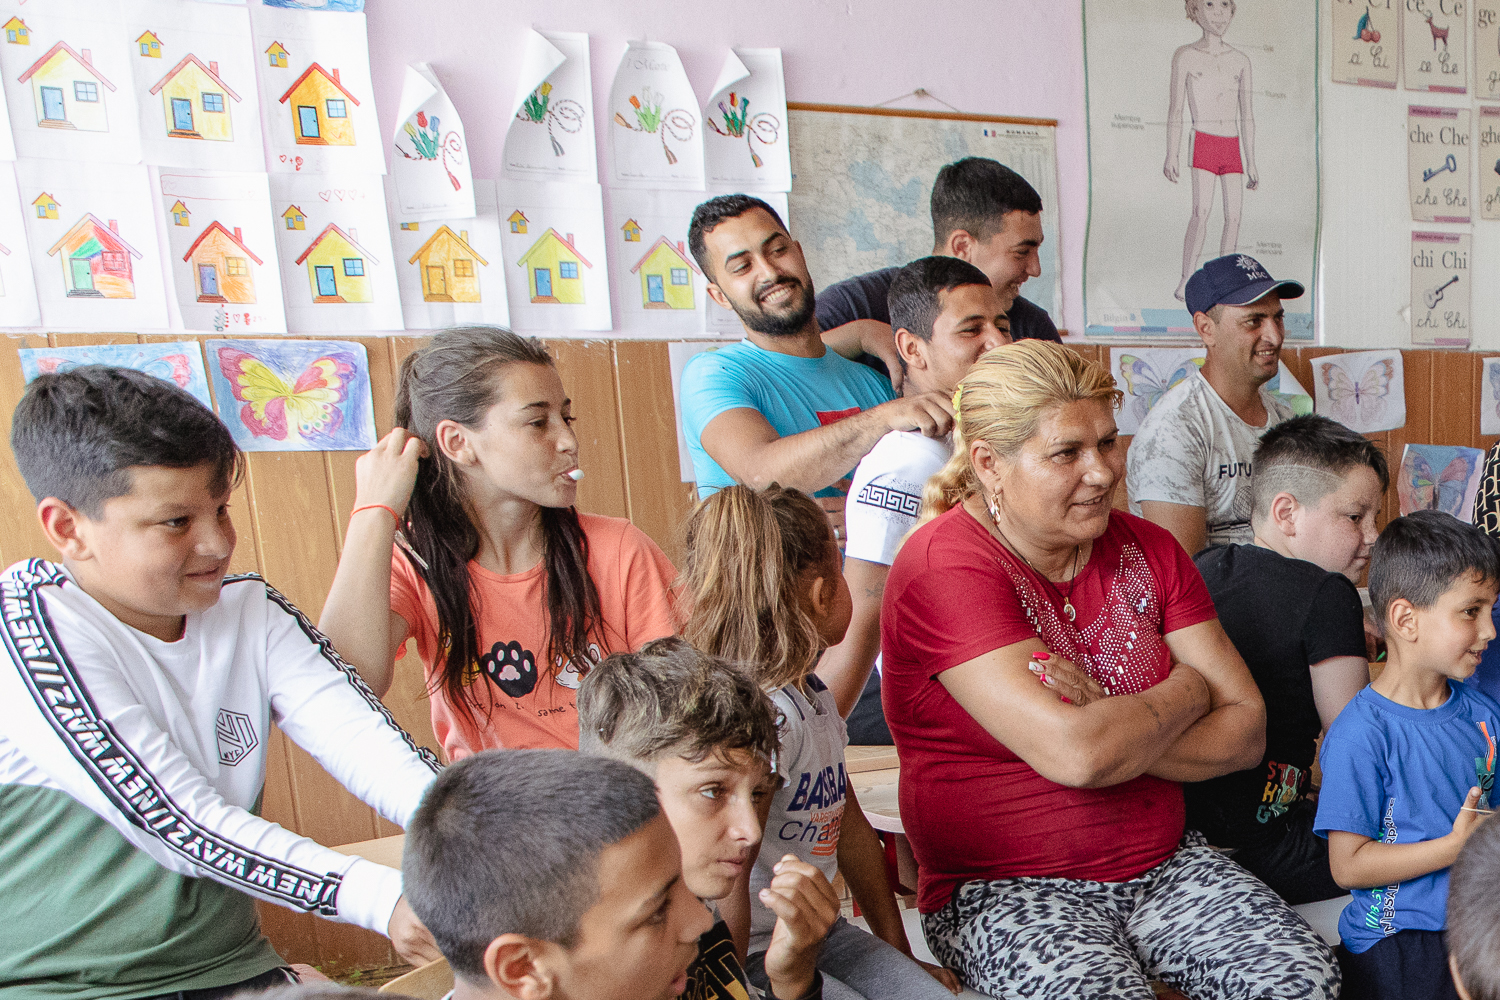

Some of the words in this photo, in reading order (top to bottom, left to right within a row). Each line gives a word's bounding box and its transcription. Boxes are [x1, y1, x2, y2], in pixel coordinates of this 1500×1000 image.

[1409, 124, 1433, 144] che
[1439, 126, 1469, 146] Che
[1413, 249, 1434, 269] chi
[1442, 250, 1468, 270] Chi
[1218, 462, 1251, 480] FUTU
